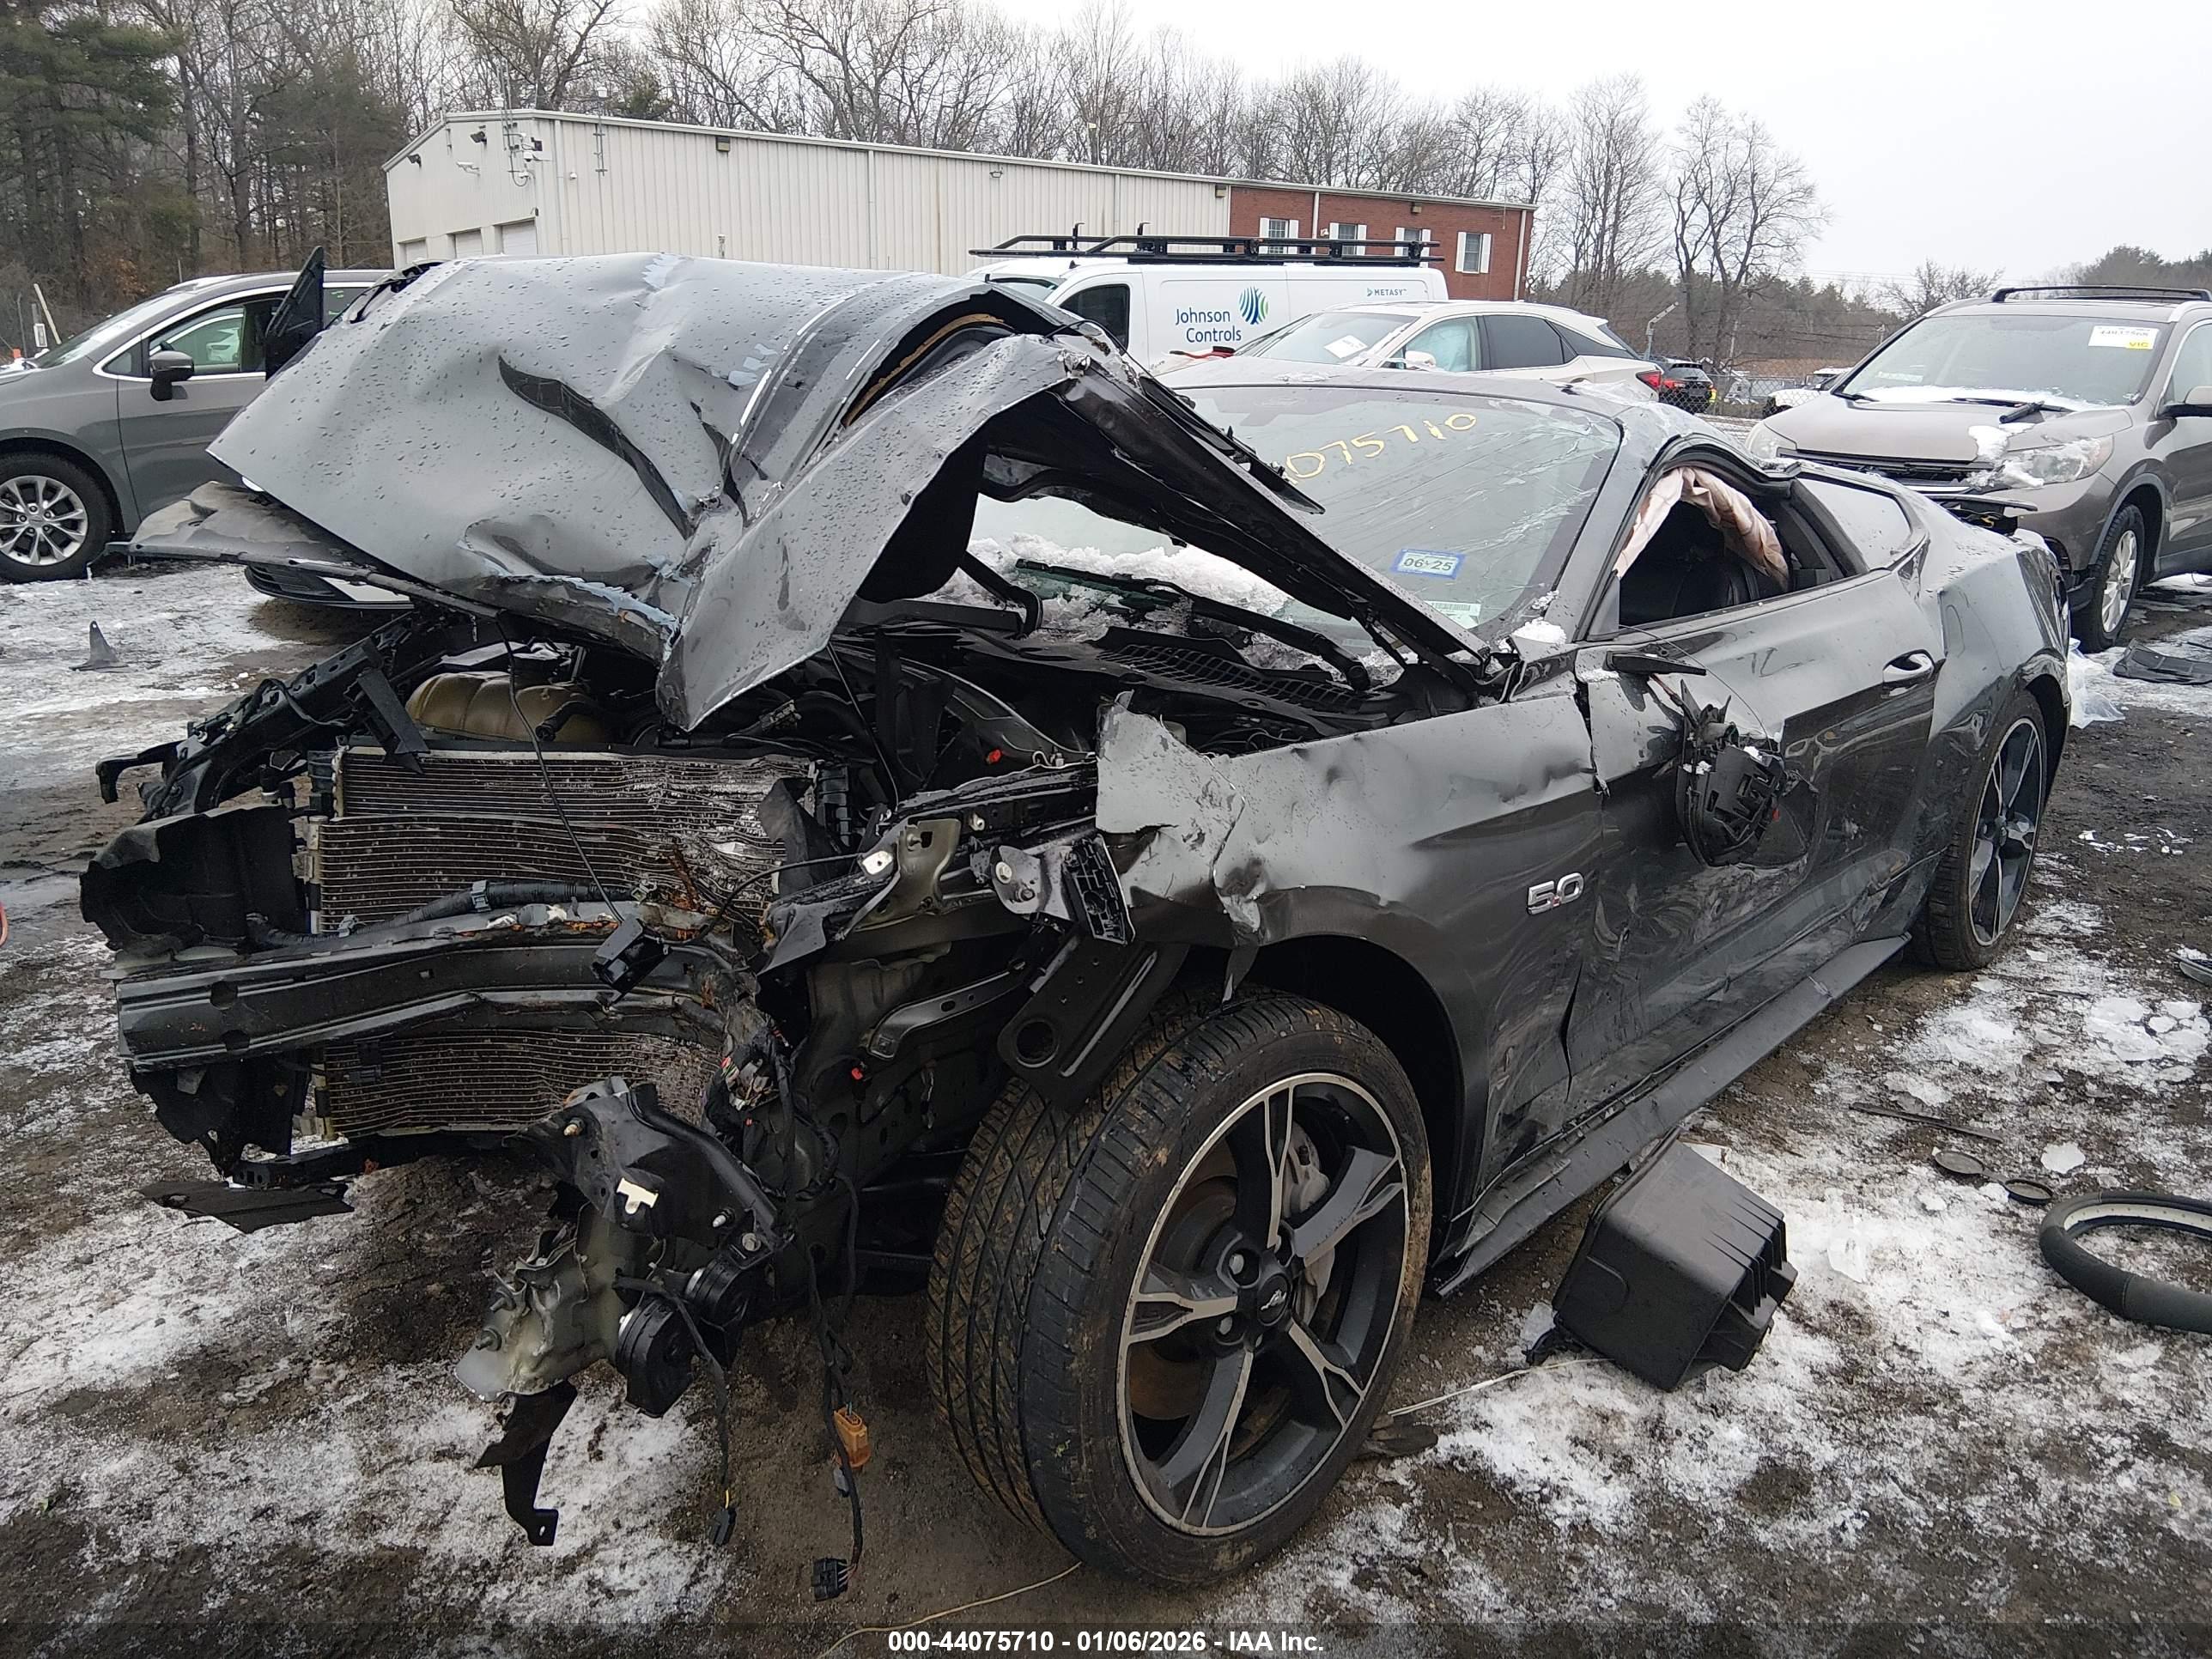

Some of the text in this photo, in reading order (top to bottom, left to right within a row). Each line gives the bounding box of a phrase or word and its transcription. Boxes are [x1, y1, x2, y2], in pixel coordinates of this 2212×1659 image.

[1176, 307, 1231, 325] Johnson
[1186, 325, 1242, 343] Controls
[1283, 413, 1477, 485] 075710
[1403, 557, 1454, 571] 06 25
[1526, 872, 1584, 915] 5.0
